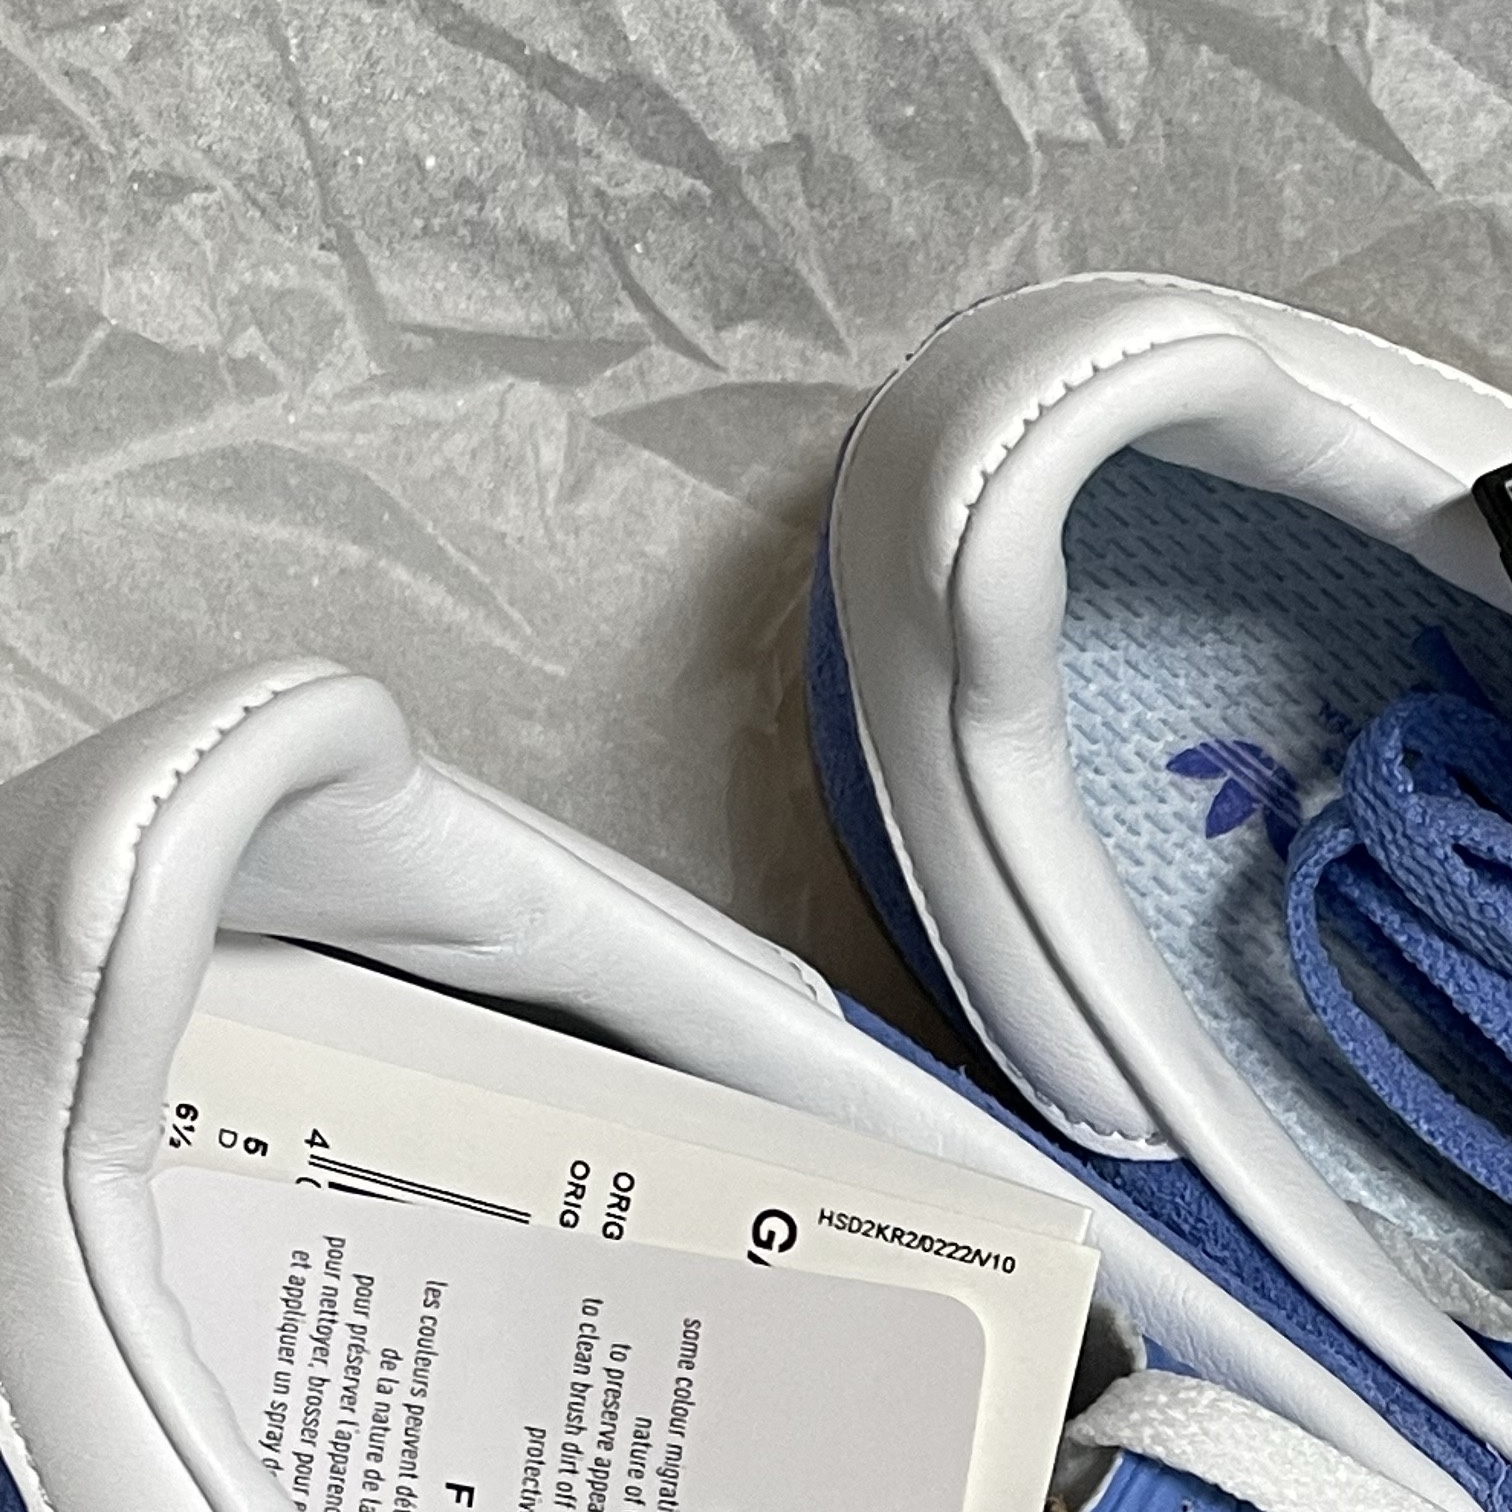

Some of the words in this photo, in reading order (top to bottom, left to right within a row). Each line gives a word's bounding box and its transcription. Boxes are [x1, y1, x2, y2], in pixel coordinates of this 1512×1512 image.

[290, 1249, 312, 1270] et
[322, 1234, 346, 1281] pour
[746, 1208, 799, 1268] G
[351, 1273, 375, 1320] pour
[422, 1280, 449, 1309] les
[581, 1298, 604, 1317] to
[276, 1274, 308, 1366] appliquer
[340, 1322, 371, 1414] préserver
[380, 1348, 404, 1371] de
[410, 1315, 440, 1399] couleurs
[573, 1323, 601, 1375] clean
[609, 1343, 632, 1362] to
[677, 1318, 701, 1371] some
[272, 1370, 291, 1395] un
[376, 1377, 400, 1395] la
[258, 1400, 288, 1454] spray
[300, 1375, 331, 1448] brosser
[564, 1381, 594, 1437] brush
[597, 1367, 625, 1452] preserve
[668, 1376, 696, 1438] colour
[366, 1401, 392, 1464] nature
[398, 1402, 425, 1479] peuvent
[628, 1416, 653, 1480] nature
[291, 1450, 314, 1496] pour
[362, 1469, 386, 1492] de
[558, 1441, 584, 1475] dirt
[445, 1481, 475, 1508] F
[554, 1481, 578, 1510] off
[623, 1485, 647, 1507] of
